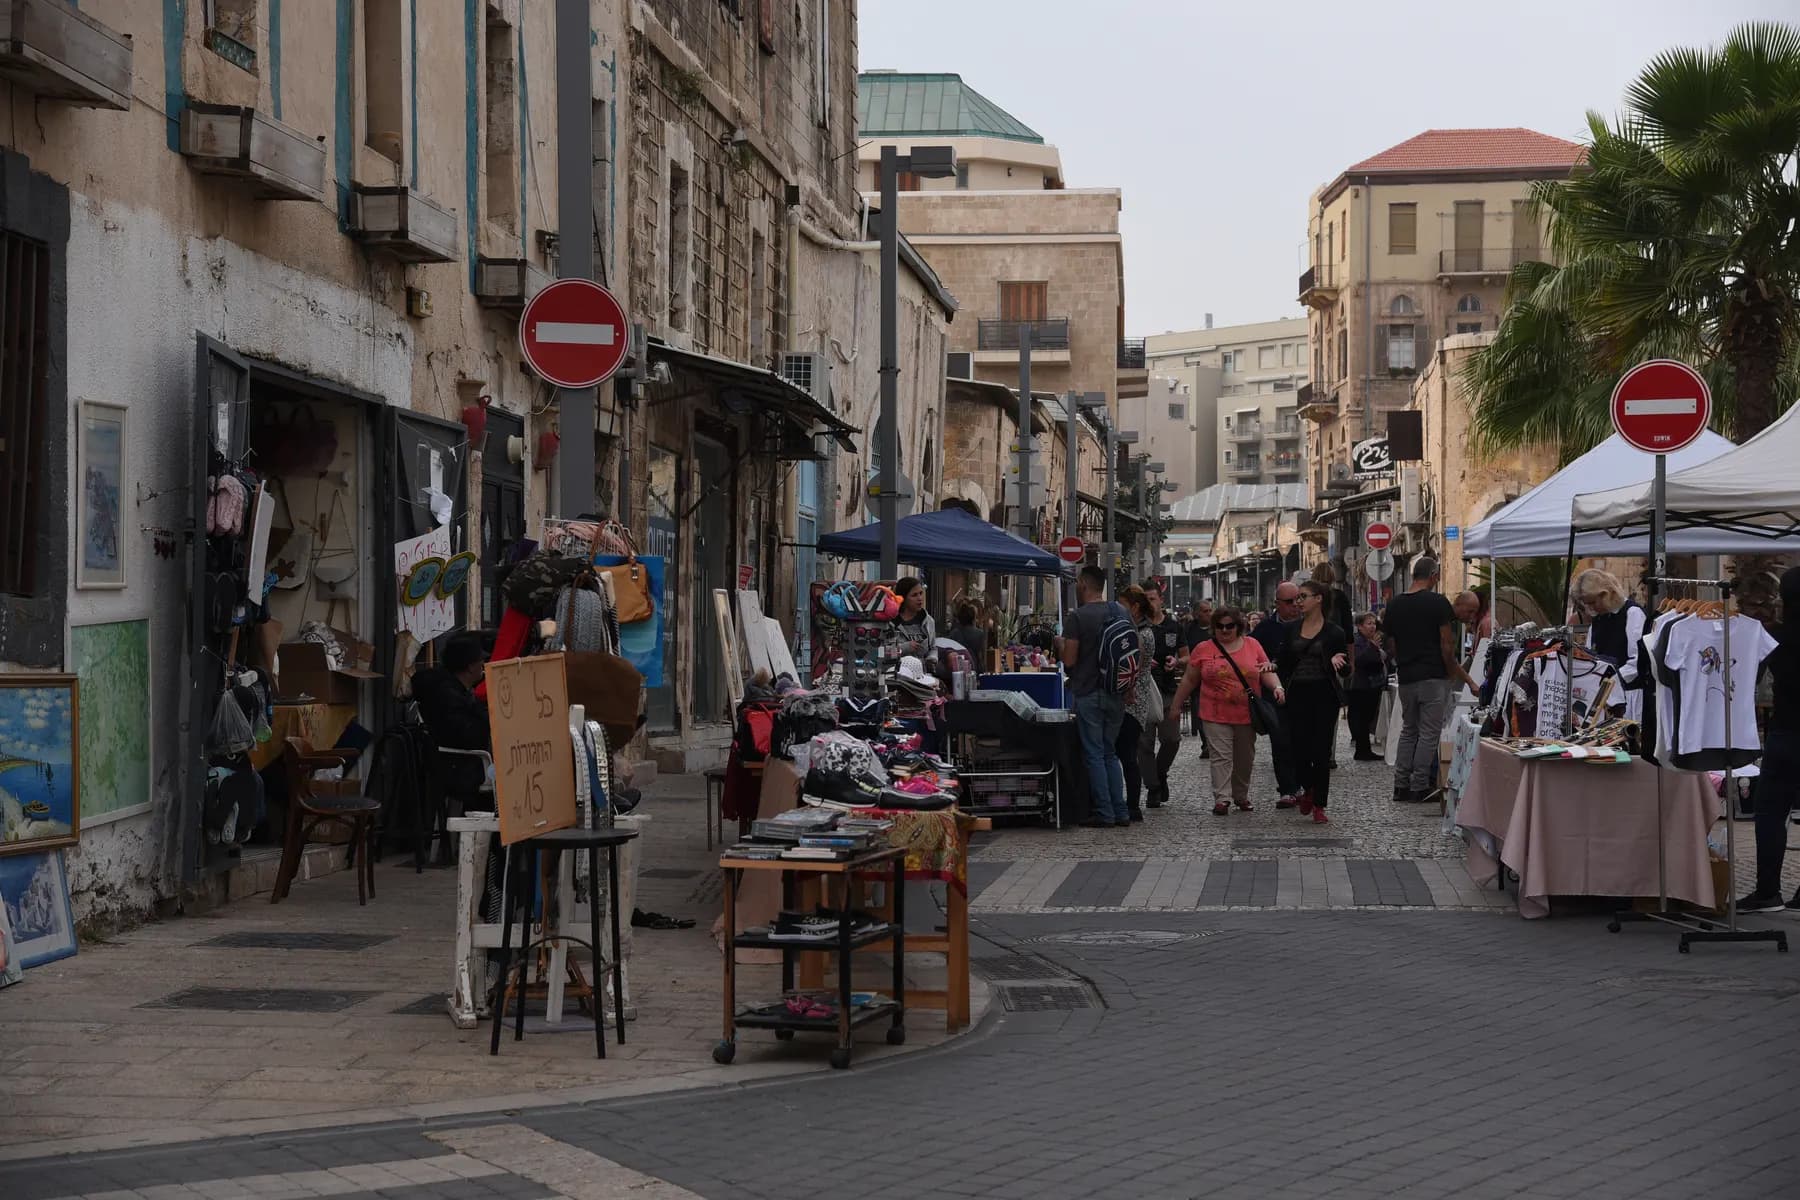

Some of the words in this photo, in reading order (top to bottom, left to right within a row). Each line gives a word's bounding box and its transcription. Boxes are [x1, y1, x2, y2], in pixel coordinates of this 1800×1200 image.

[647, 526, 676, 565] OUTLET
[533, 672, 553, 719] כל
[524, 772, 544, 815] 15
